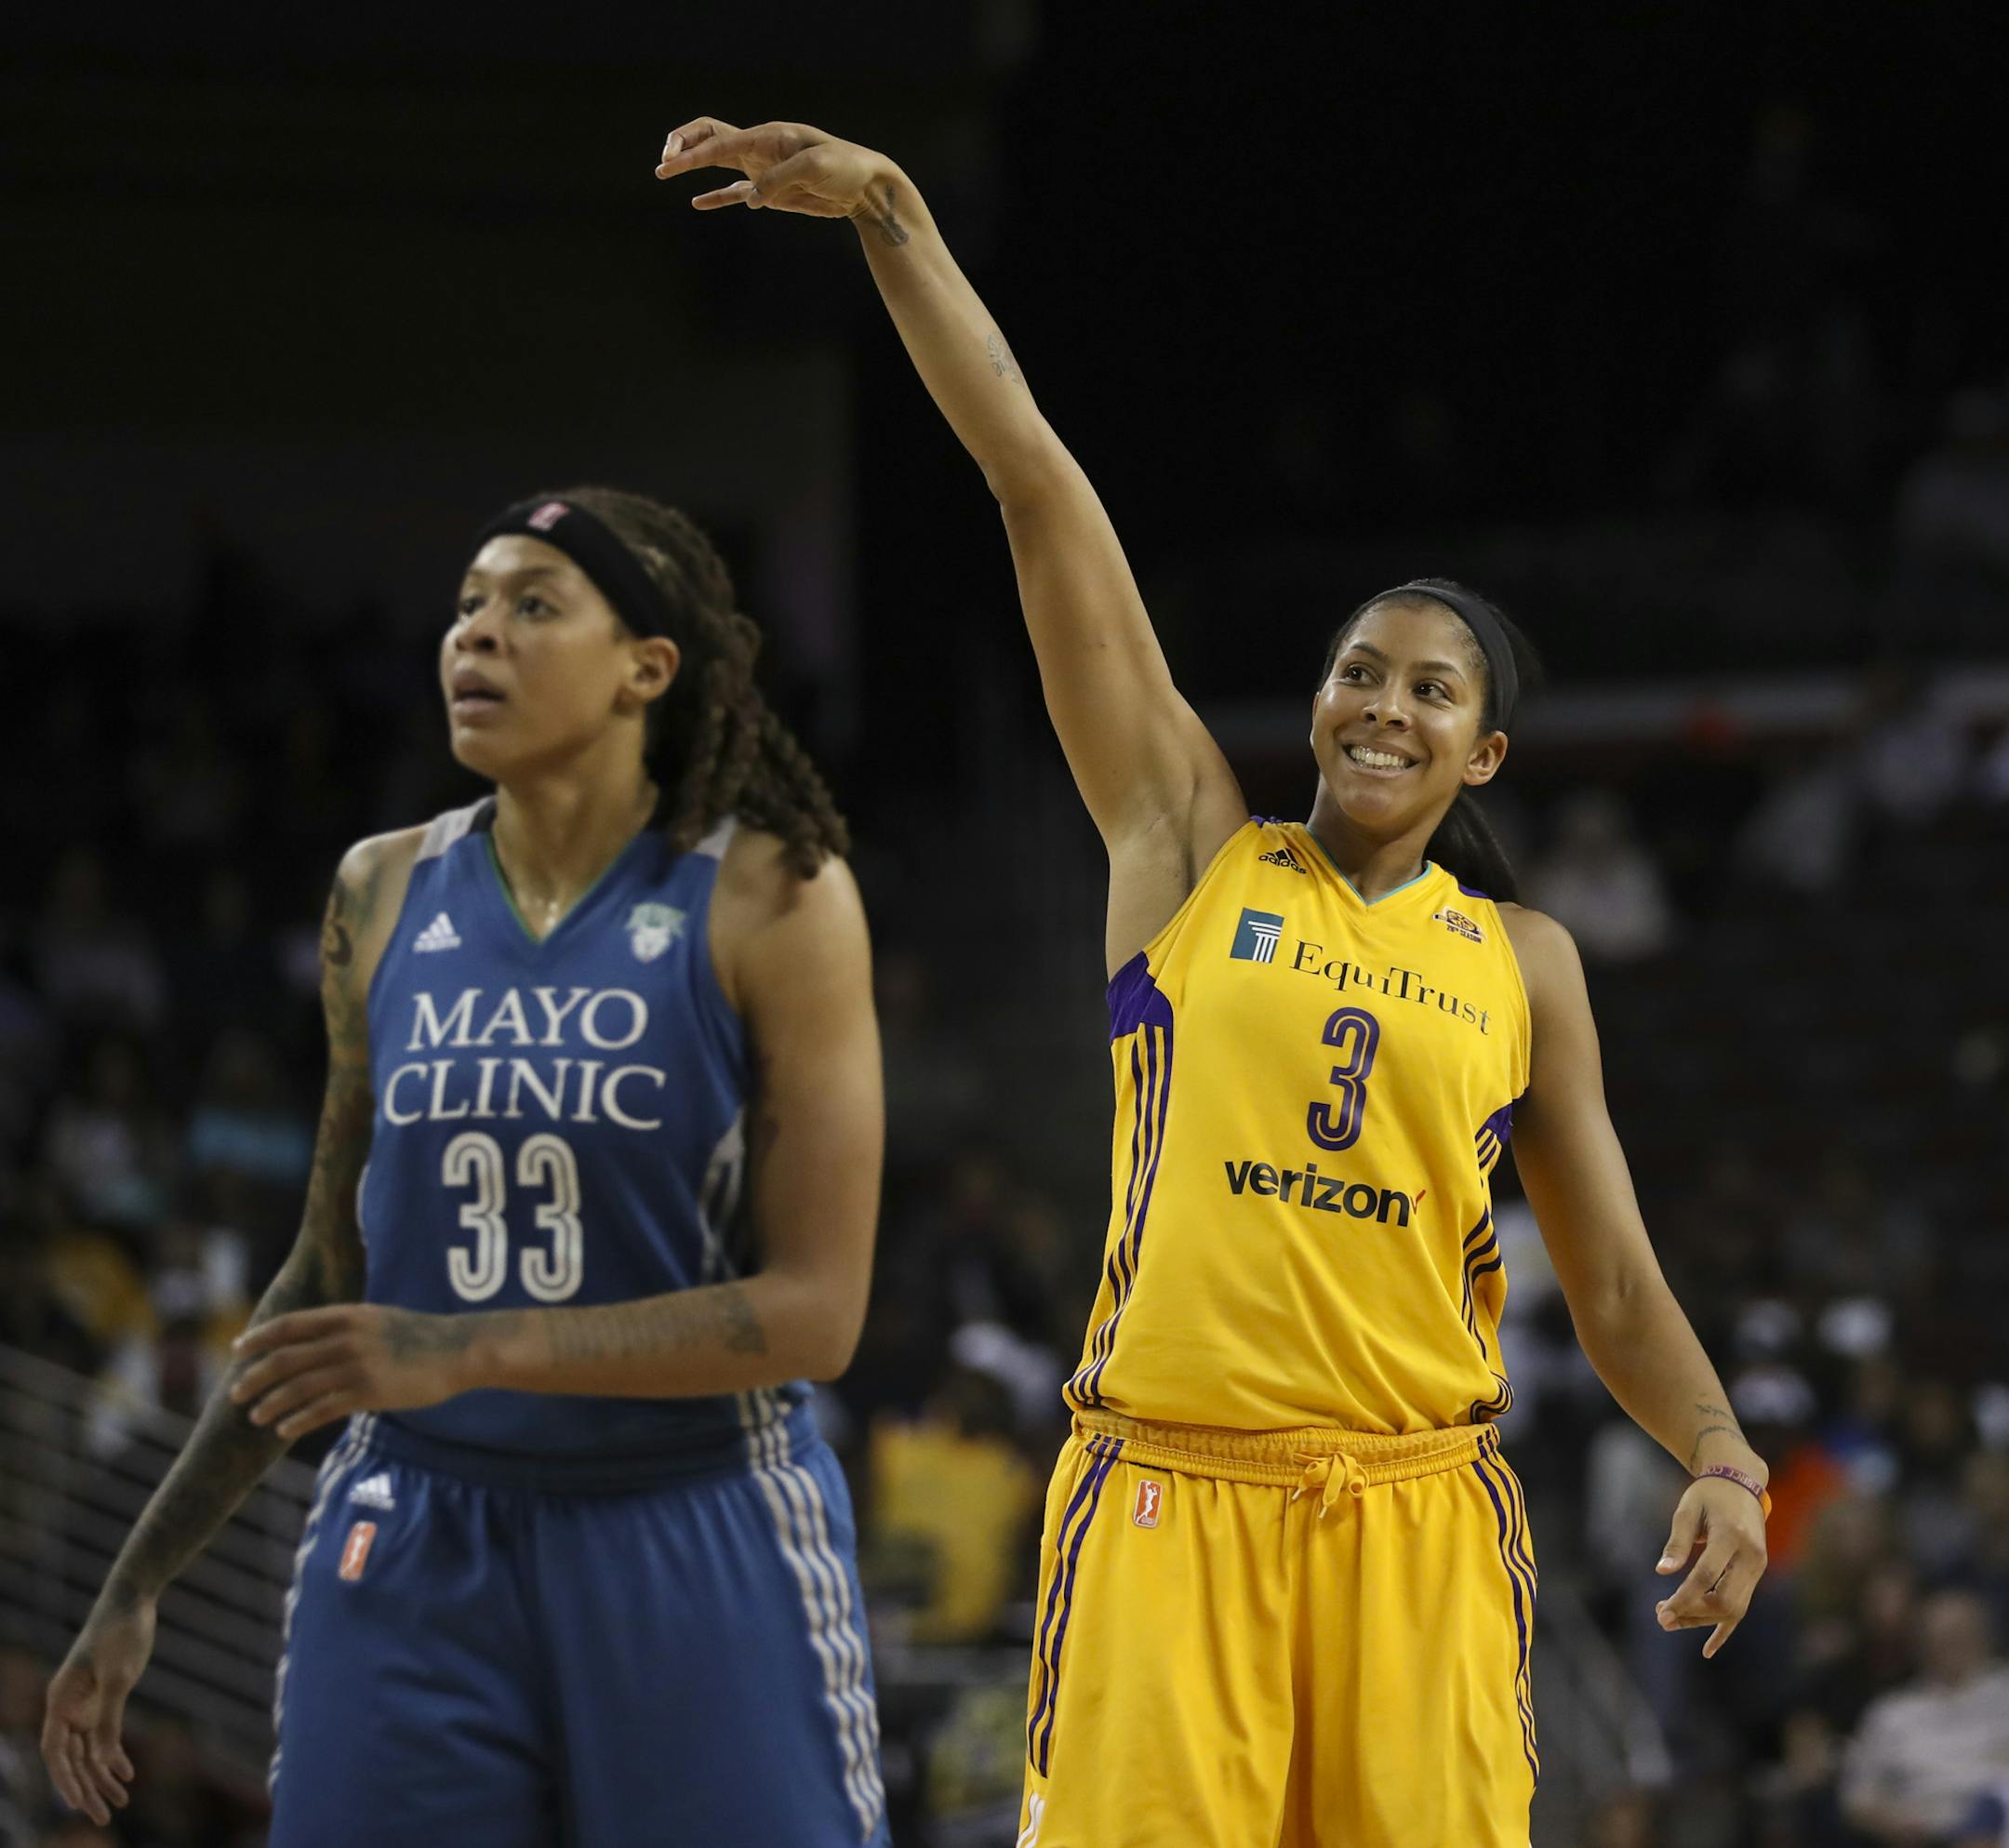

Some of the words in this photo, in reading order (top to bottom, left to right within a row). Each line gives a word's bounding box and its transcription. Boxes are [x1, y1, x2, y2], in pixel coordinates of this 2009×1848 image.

[1258, 848, 1307, 874] adidas
[406, 987, 649, 1051] MAYO
[1289, 939, 1492, 1035] EquiTrust
[383, 1058, 666, 1130] CLINIC
[1307, 1006, 1381, 1151] 3
[442, 1132, 584, 1302] 33
[1224, 1160, 1411, 1227] verizon
